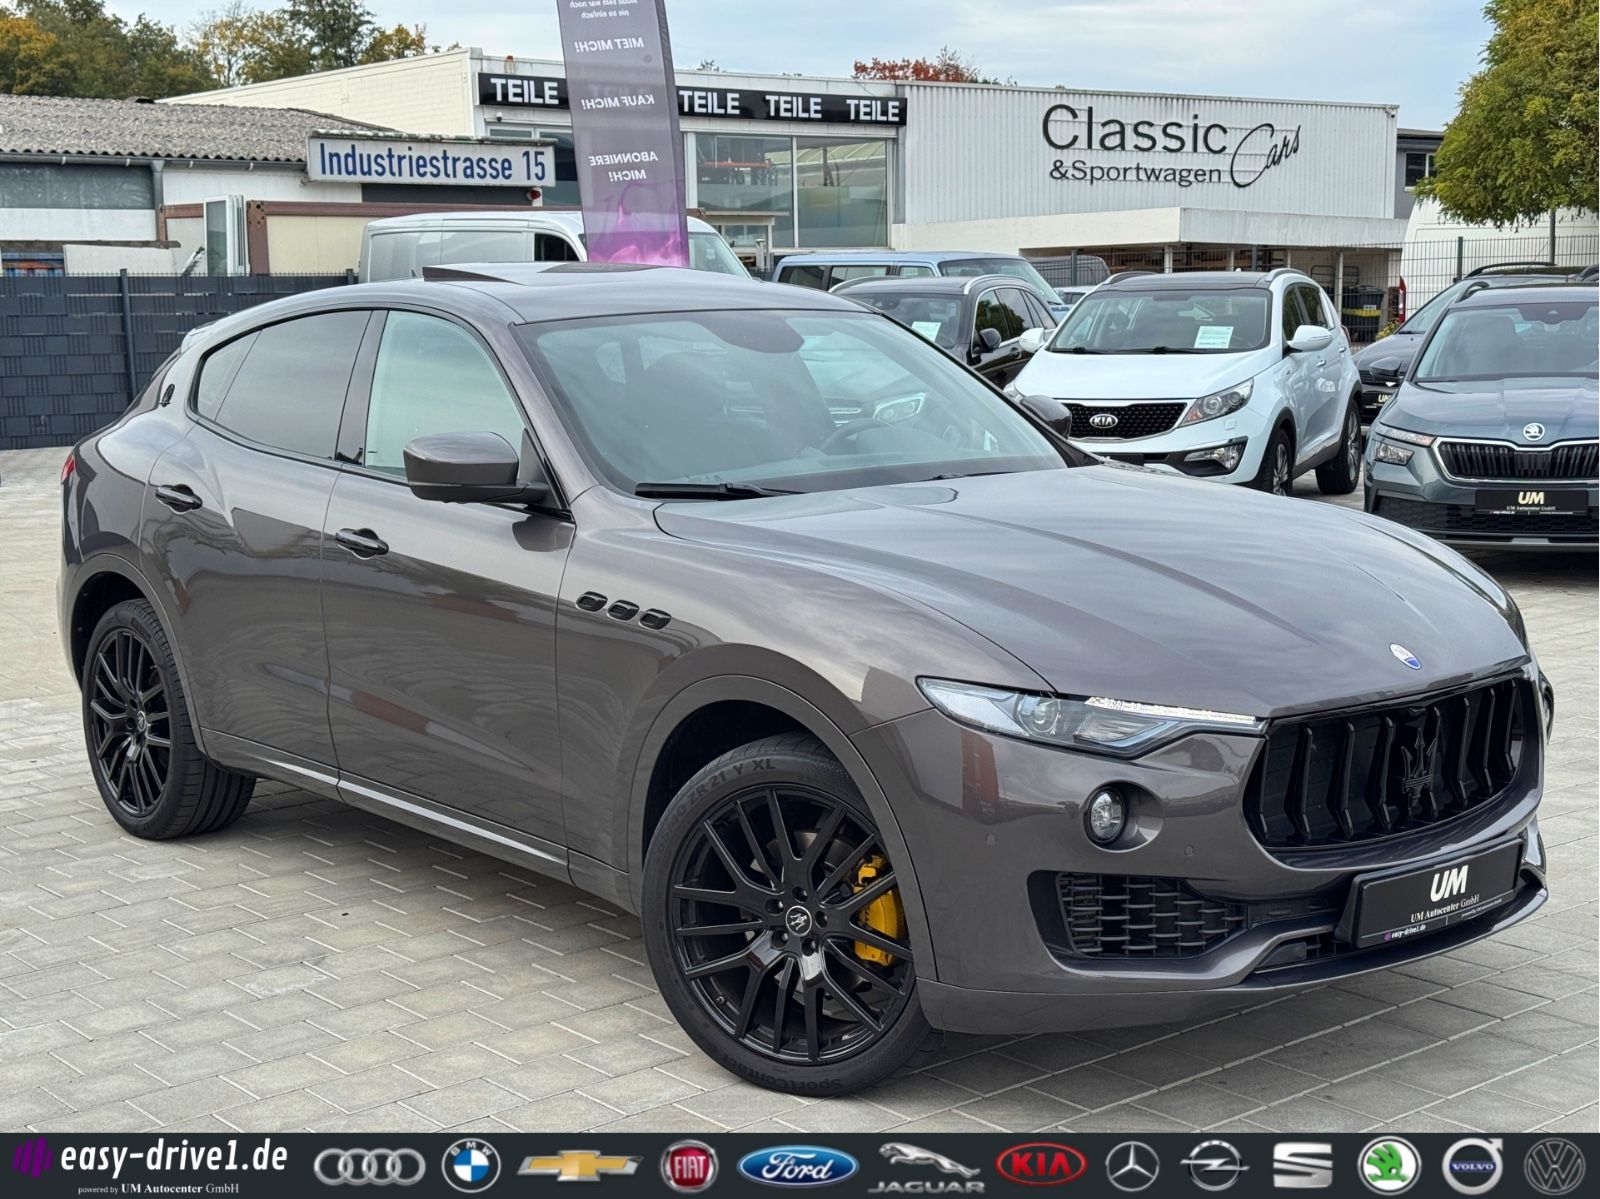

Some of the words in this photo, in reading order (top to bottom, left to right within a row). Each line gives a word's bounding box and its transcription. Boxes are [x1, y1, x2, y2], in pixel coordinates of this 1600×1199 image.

[490, 77, 559, 105] TEILE
[678, 90, 740, 114] TEILE
[765, 95, 822, 119] TEILE
[846, 99, 900, 122] TEILE
[1042, 103, 1228, 154] Classic
[319, 142, 513, 180] Industriestrasse
[522, 150, 546, 181] 15
[1230, 123, 1301, 188] Cars
[1049, 159, 1221, 188] &Sportwagen
[1093, 416, 1113, 426] KIA
[1518, 491, 1545, 505] UM
[708, 771, 727, 788] 21
[733, 763, 744, 775] Y
[752, 758, 776, 771] XL
[1430, 864, 1469, 902] UM
[1410, 911, 1424, 923] UM
[1424, 902, 1460, 919] Autocenter
[1460, 894, 1480, 908] GmbH
